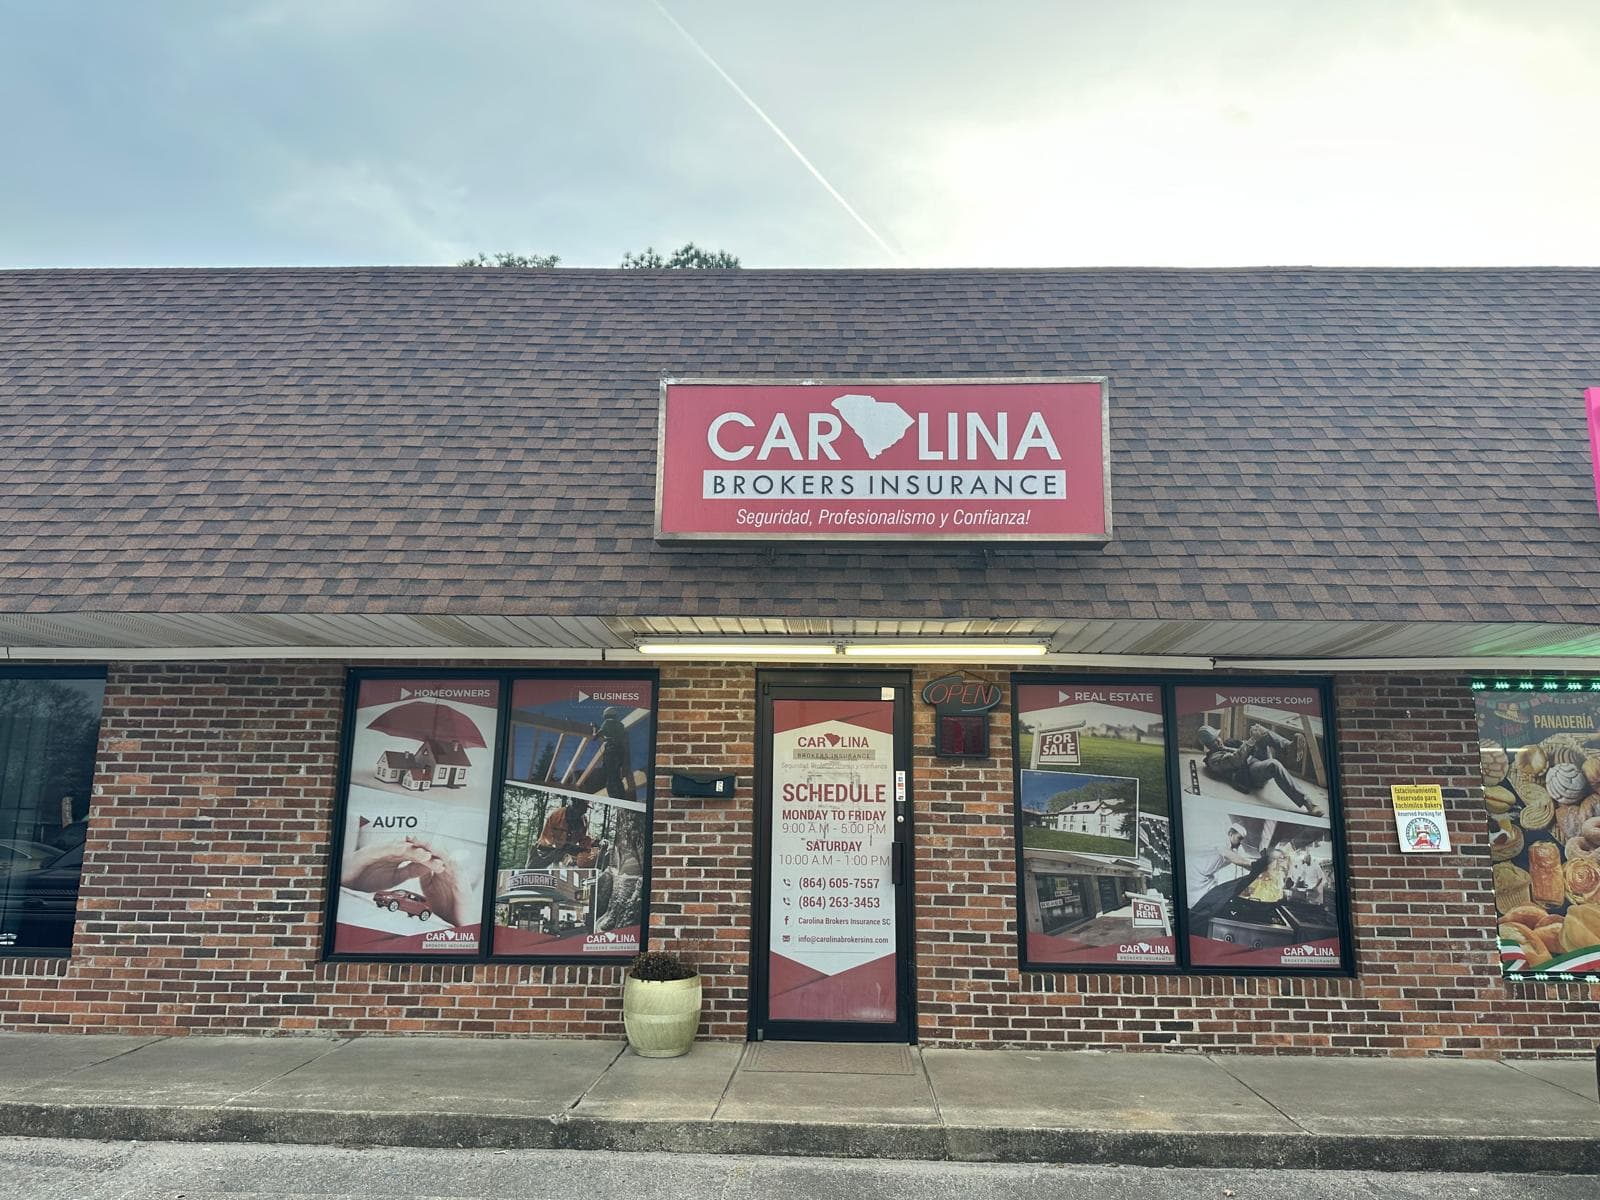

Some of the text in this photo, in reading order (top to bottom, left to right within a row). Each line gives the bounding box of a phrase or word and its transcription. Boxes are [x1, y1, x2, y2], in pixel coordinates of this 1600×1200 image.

[713, 475, 1058, 495] BROKERS INSURANCE
[736, 508, 1031, 528] Seguridad, Profesionalismo y Confianza!
[414, 689, 490, 697] HOMEOWNERS
[593, 692, 639, 700] BUSINESS
[929, 684, 994, 704] OPEN
[1075, 691, 1153, 702] REAL ESTATE
[1230, 696, 1313, 704] WORKER'S COMP
[1533, 713, 1594, 729] PANADERÍA
[1046, 733, 1072, 744] FOR
[1042, 743, 1076, 755] SALE
[782, 784, 887, 802] SCHEDULE
[782, 810, 887, 821] MONDAY TO FRIDAY
[372, 816, 418, 829] AUTO
[782, 823, 806, 833] 9:00
[841, 823, 864, 834] 5:00
[806, 840, 862, 851] SATURDAY
[779, 854, 809, 865] 10:00
[845, 855, 868, 866] 1:00
[507, 874, 553, 887] ESTAURANT
[799, 877, 880, 890] (864) 605-7557
[799, 896, 880, 909] (864) 263-3453
[1138, 903, 1156, 911] FOR
[1136, 910, 1159, 919] RENT
[798, 917, 824, 925] Carolina
[825, 917, 849, 925] Brokers
[798, 935, 889, 944] info@carolinabrokersins.com
